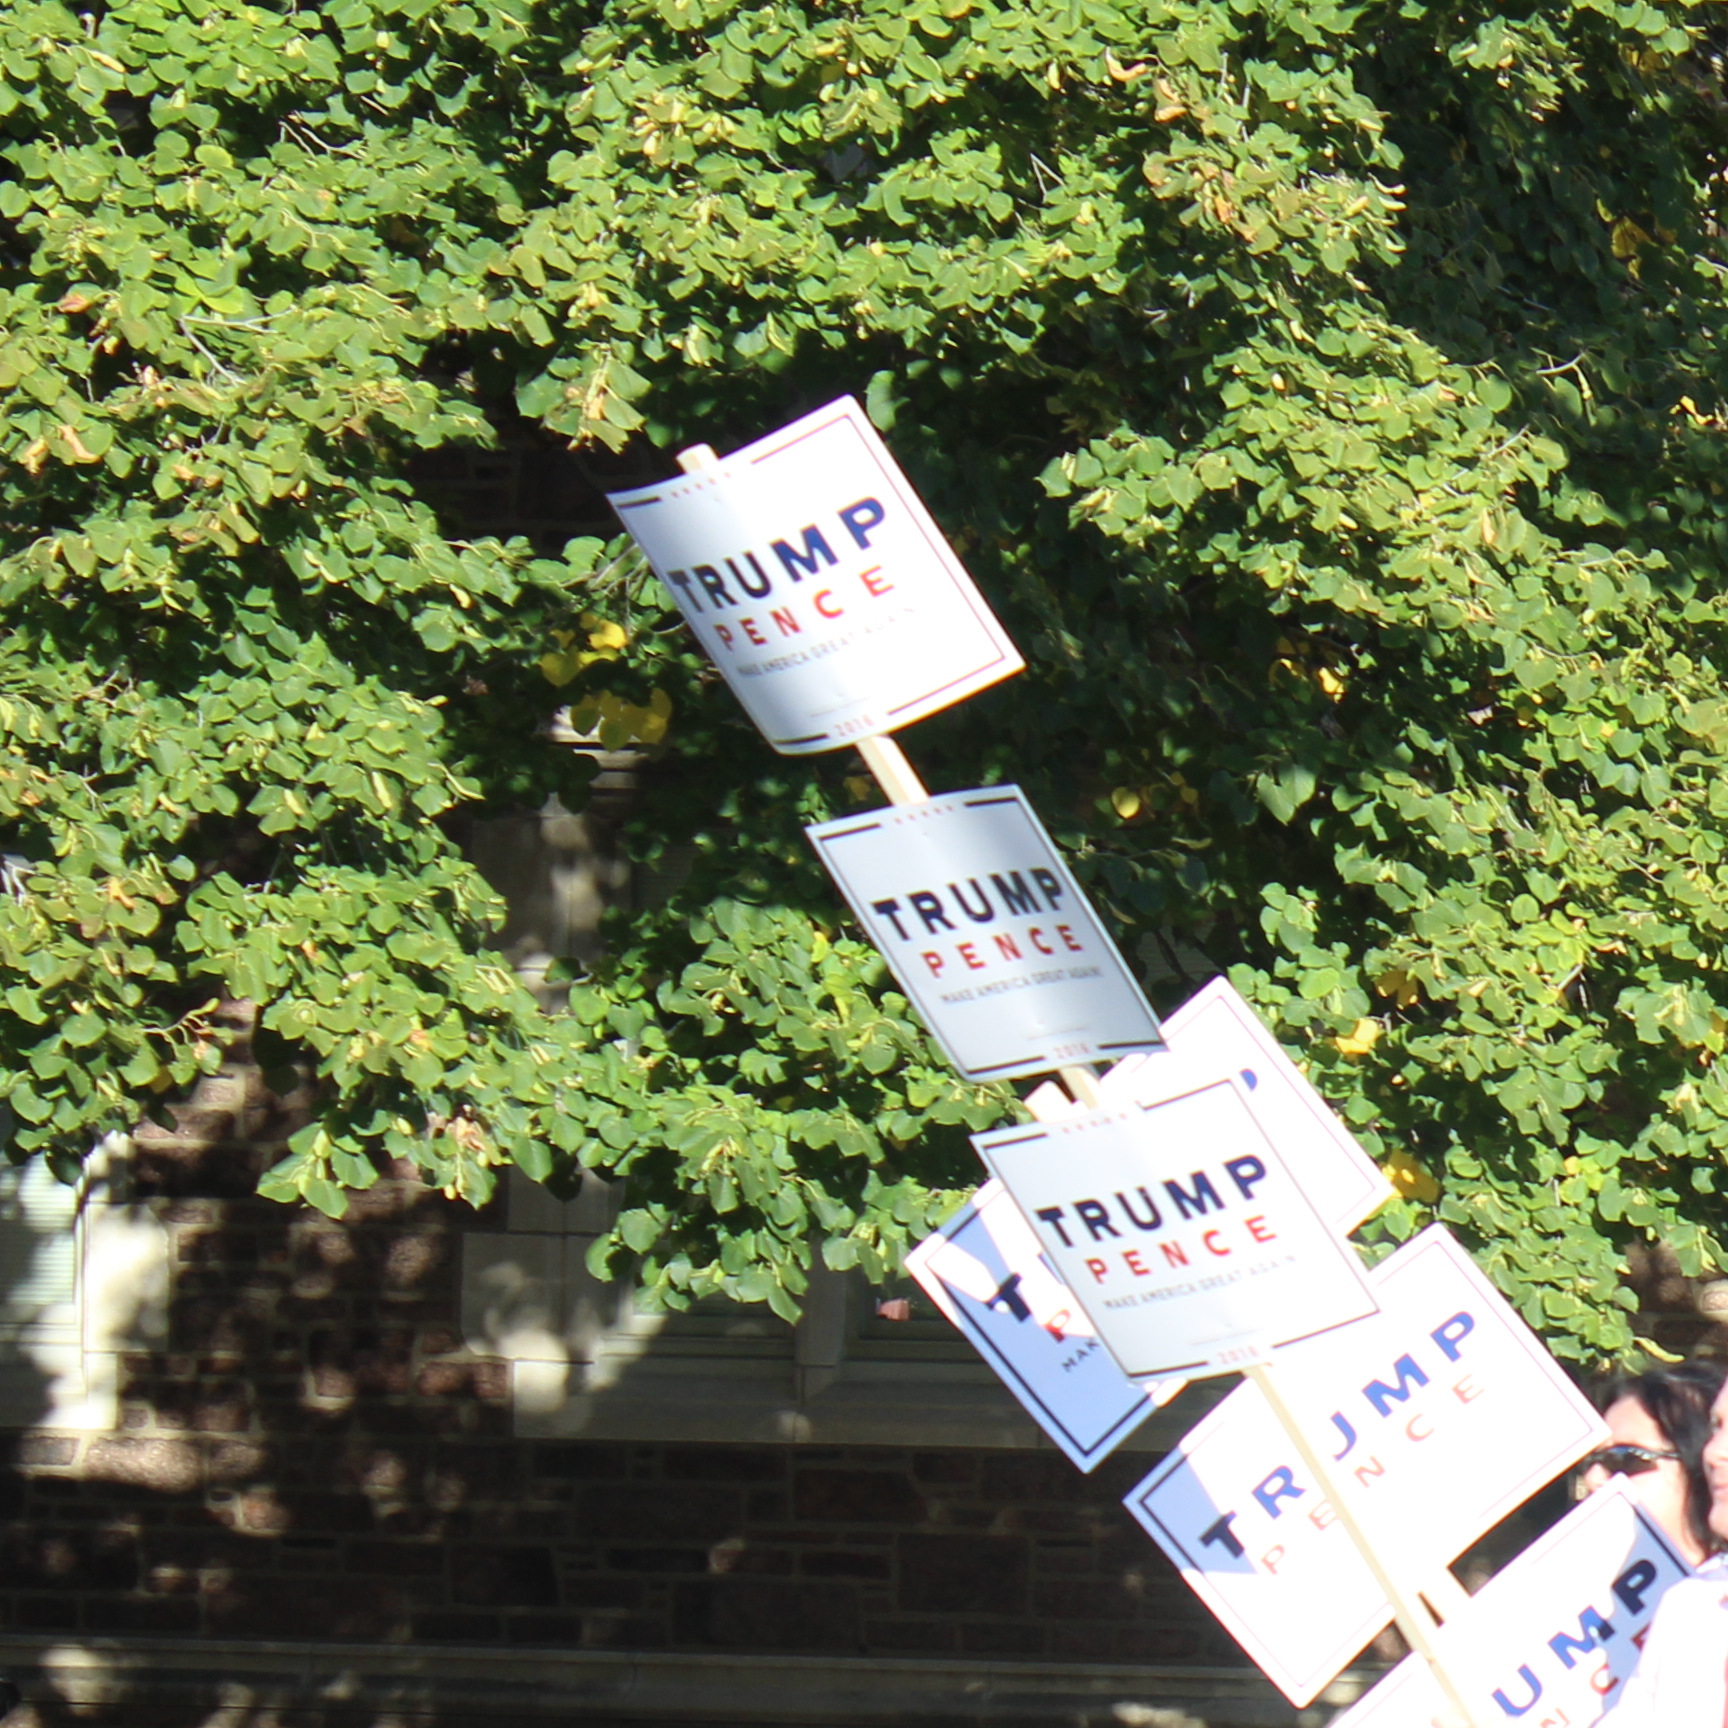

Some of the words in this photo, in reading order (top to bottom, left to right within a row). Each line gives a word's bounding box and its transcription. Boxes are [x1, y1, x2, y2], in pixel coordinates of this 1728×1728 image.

[667, 496, 886, 613] TRUMP
[713, 565, 895, 651] PENCE
[870, 868, 1064, 941] TRUMP
[920, 924, 1084, 978] PENCE
[1034, 1154, 1267, 1247] TRUMP
[1085, 1215, 1278, 1284] PENCE
[1138, 1283, 1198, 1304] AMERICA
[1062, 1339, 1100, 1373] MAK
